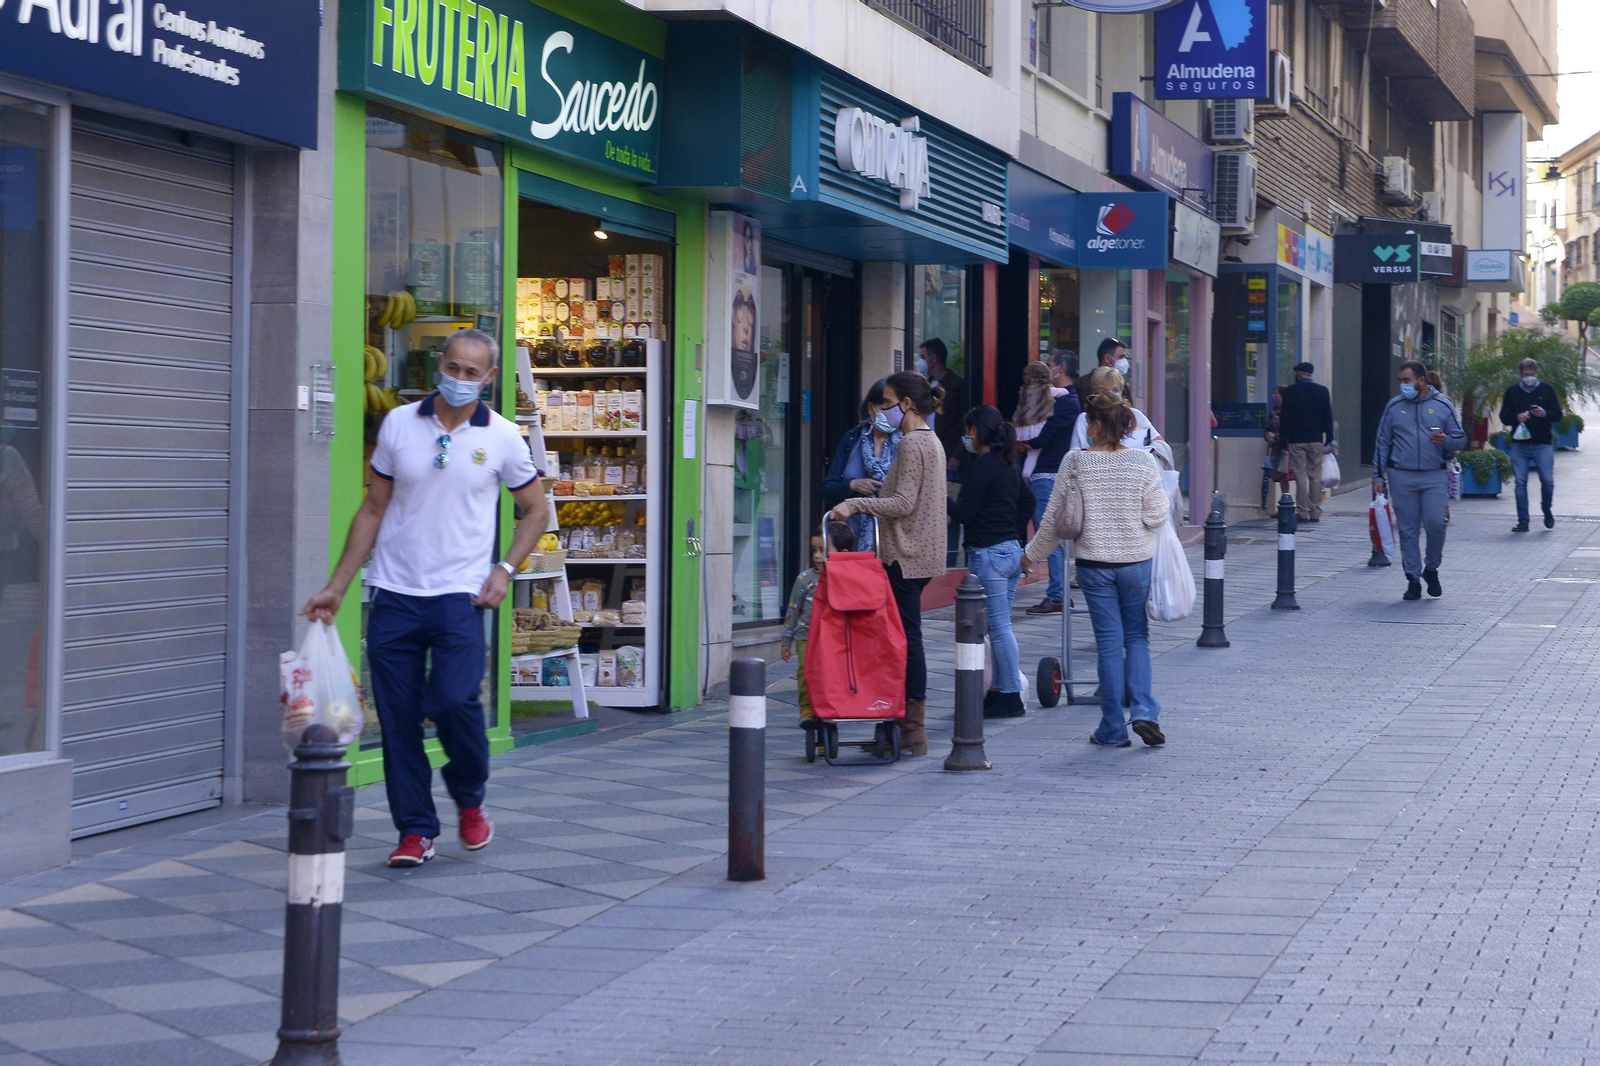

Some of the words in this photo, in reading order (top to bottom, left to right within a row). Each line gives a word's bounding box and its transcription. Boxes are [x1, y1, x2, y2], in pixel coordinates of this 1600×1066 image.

[372, 0, 527, 117] FRUTERIA
[1166, 63, 1255, 79] Almudena
[530, 30, 658, 139] Saucedo
[1165, 80, 1255, 93] seguros
[791, 175, 807, 192] A
[1086, 235, 1145, 252] algetoner
[1372, 265, 1412, 273] VERSUS
